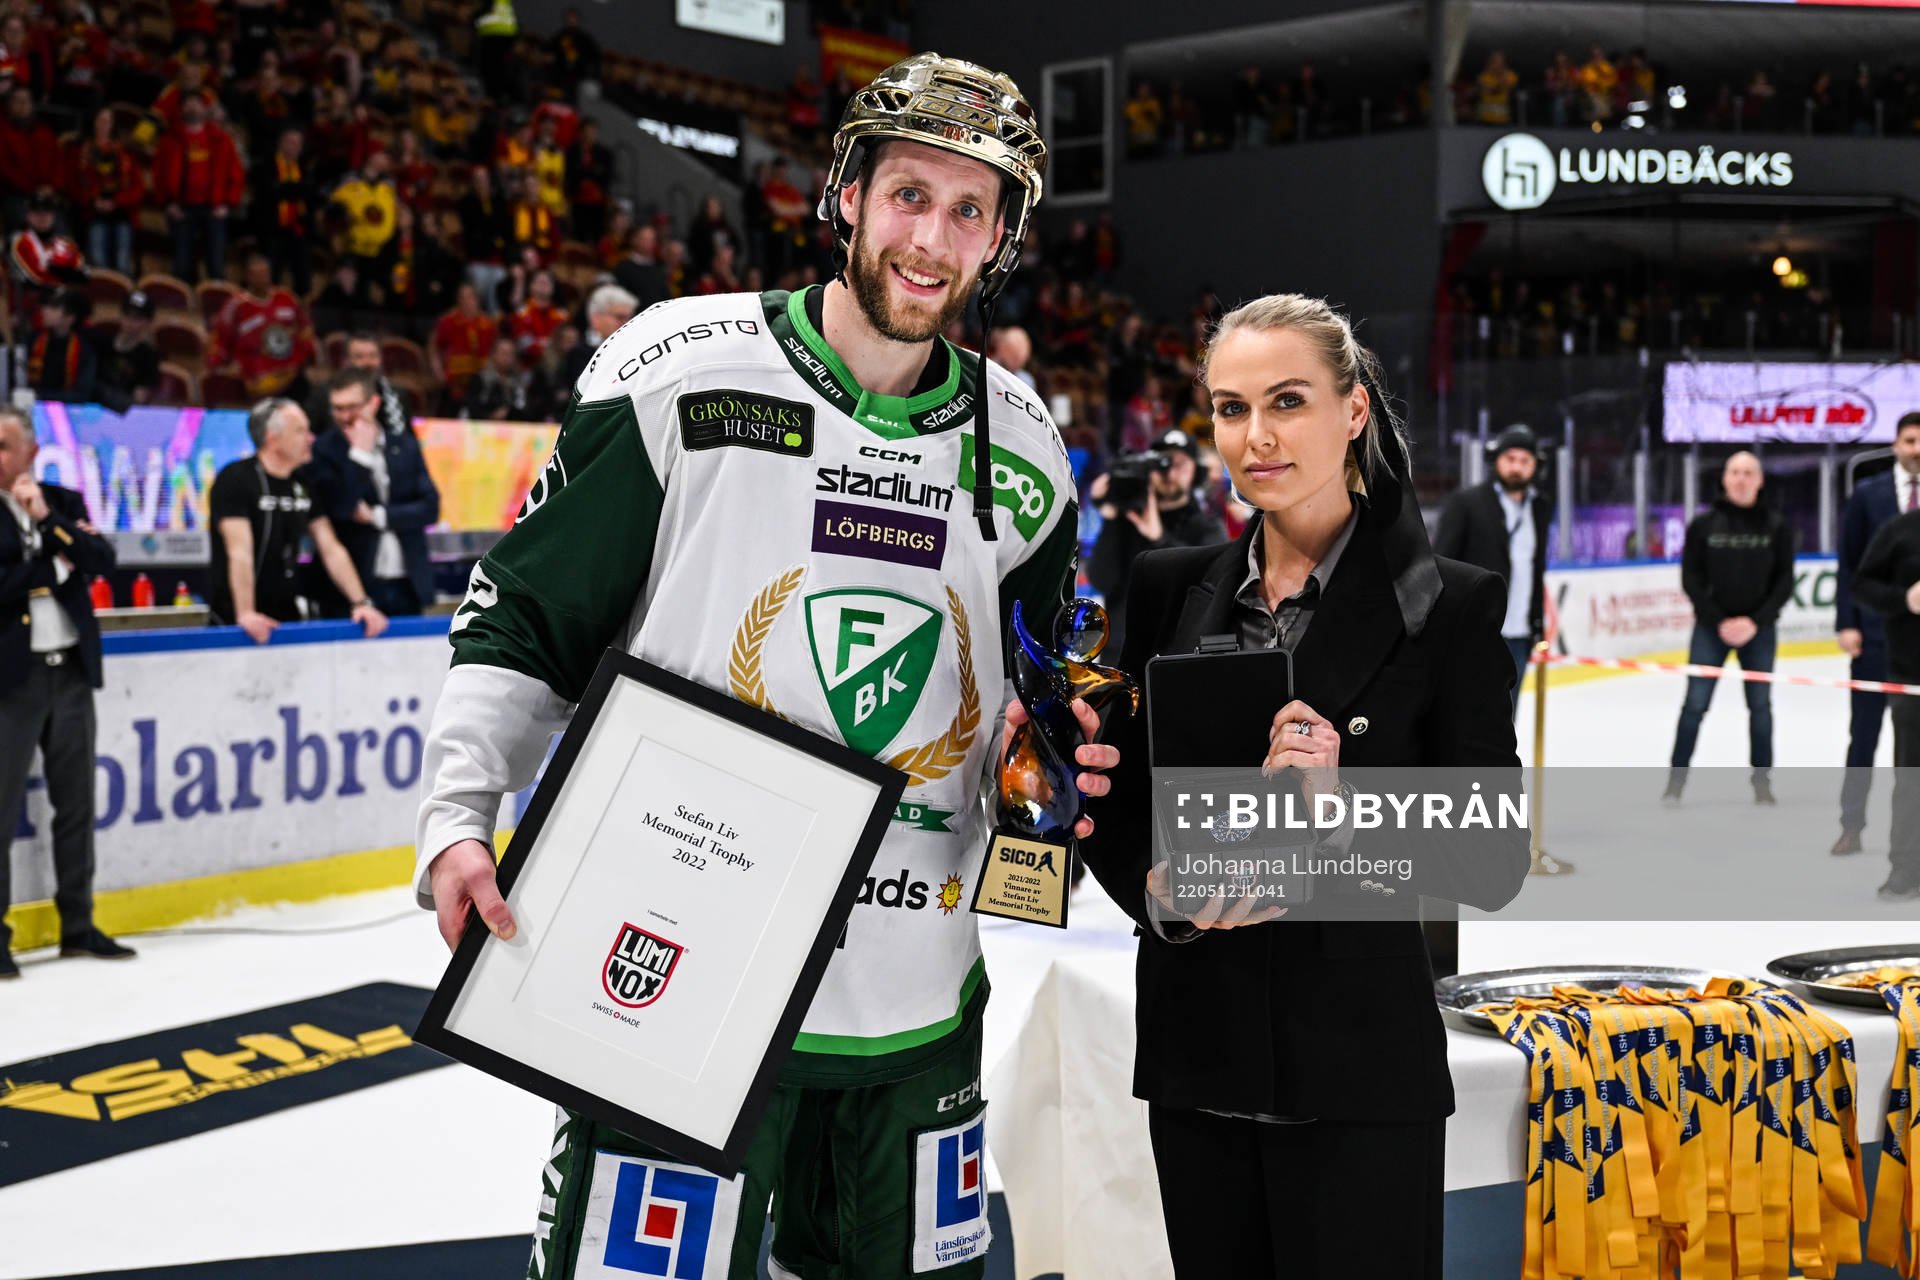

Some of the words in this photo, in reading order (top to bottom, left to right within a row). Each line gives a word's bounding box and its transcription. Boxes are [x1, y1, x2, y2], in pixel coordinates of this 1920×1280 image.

[1559, 145, 1793, 186] LUNDBÄCKS
[784, 337, 843, 399] stadium
[689, 396, 801, 427] GRÖNSAKS
[922, 393, 974, 429] stadium
[724, 420, 785, 444] HUSET
[859, 446, 921, 465] CCM
[816, 464, 953, 512] stadium
[825, 516, 936, 552] LÖFBERGS
[835, 607, 885, 677] F
[14, 698, 421, 838] olarbrö
[674, 804, 714, 831] Stefan
[716, 822, 740, 841] Liv
[641, 812, 706, 849] Memorial
[709, 840, 755, 872] Trophy
[999, 847, 1036, 867] SICO
[672, 848, 707, 871] 2022
[1003, 882, 1032, 894] Vinnare
[1008, 873, 1041, 886] 2021/2022
[988, 897, 1024, 910] Memorial
[1025, 904, 1051, 917] Trophy
[1002, 891, 1026, 902] Stefan
[1027, 895, 1039, 904] Liv
[616, 929, 676, 975] LUMI
[608, 959, 661, 1001] NOX
[592, 1001, 614, 1016] SWISS
[620, 1014, 641, 1028] MADE
[936, 1242, 976, 1263] Värmland
